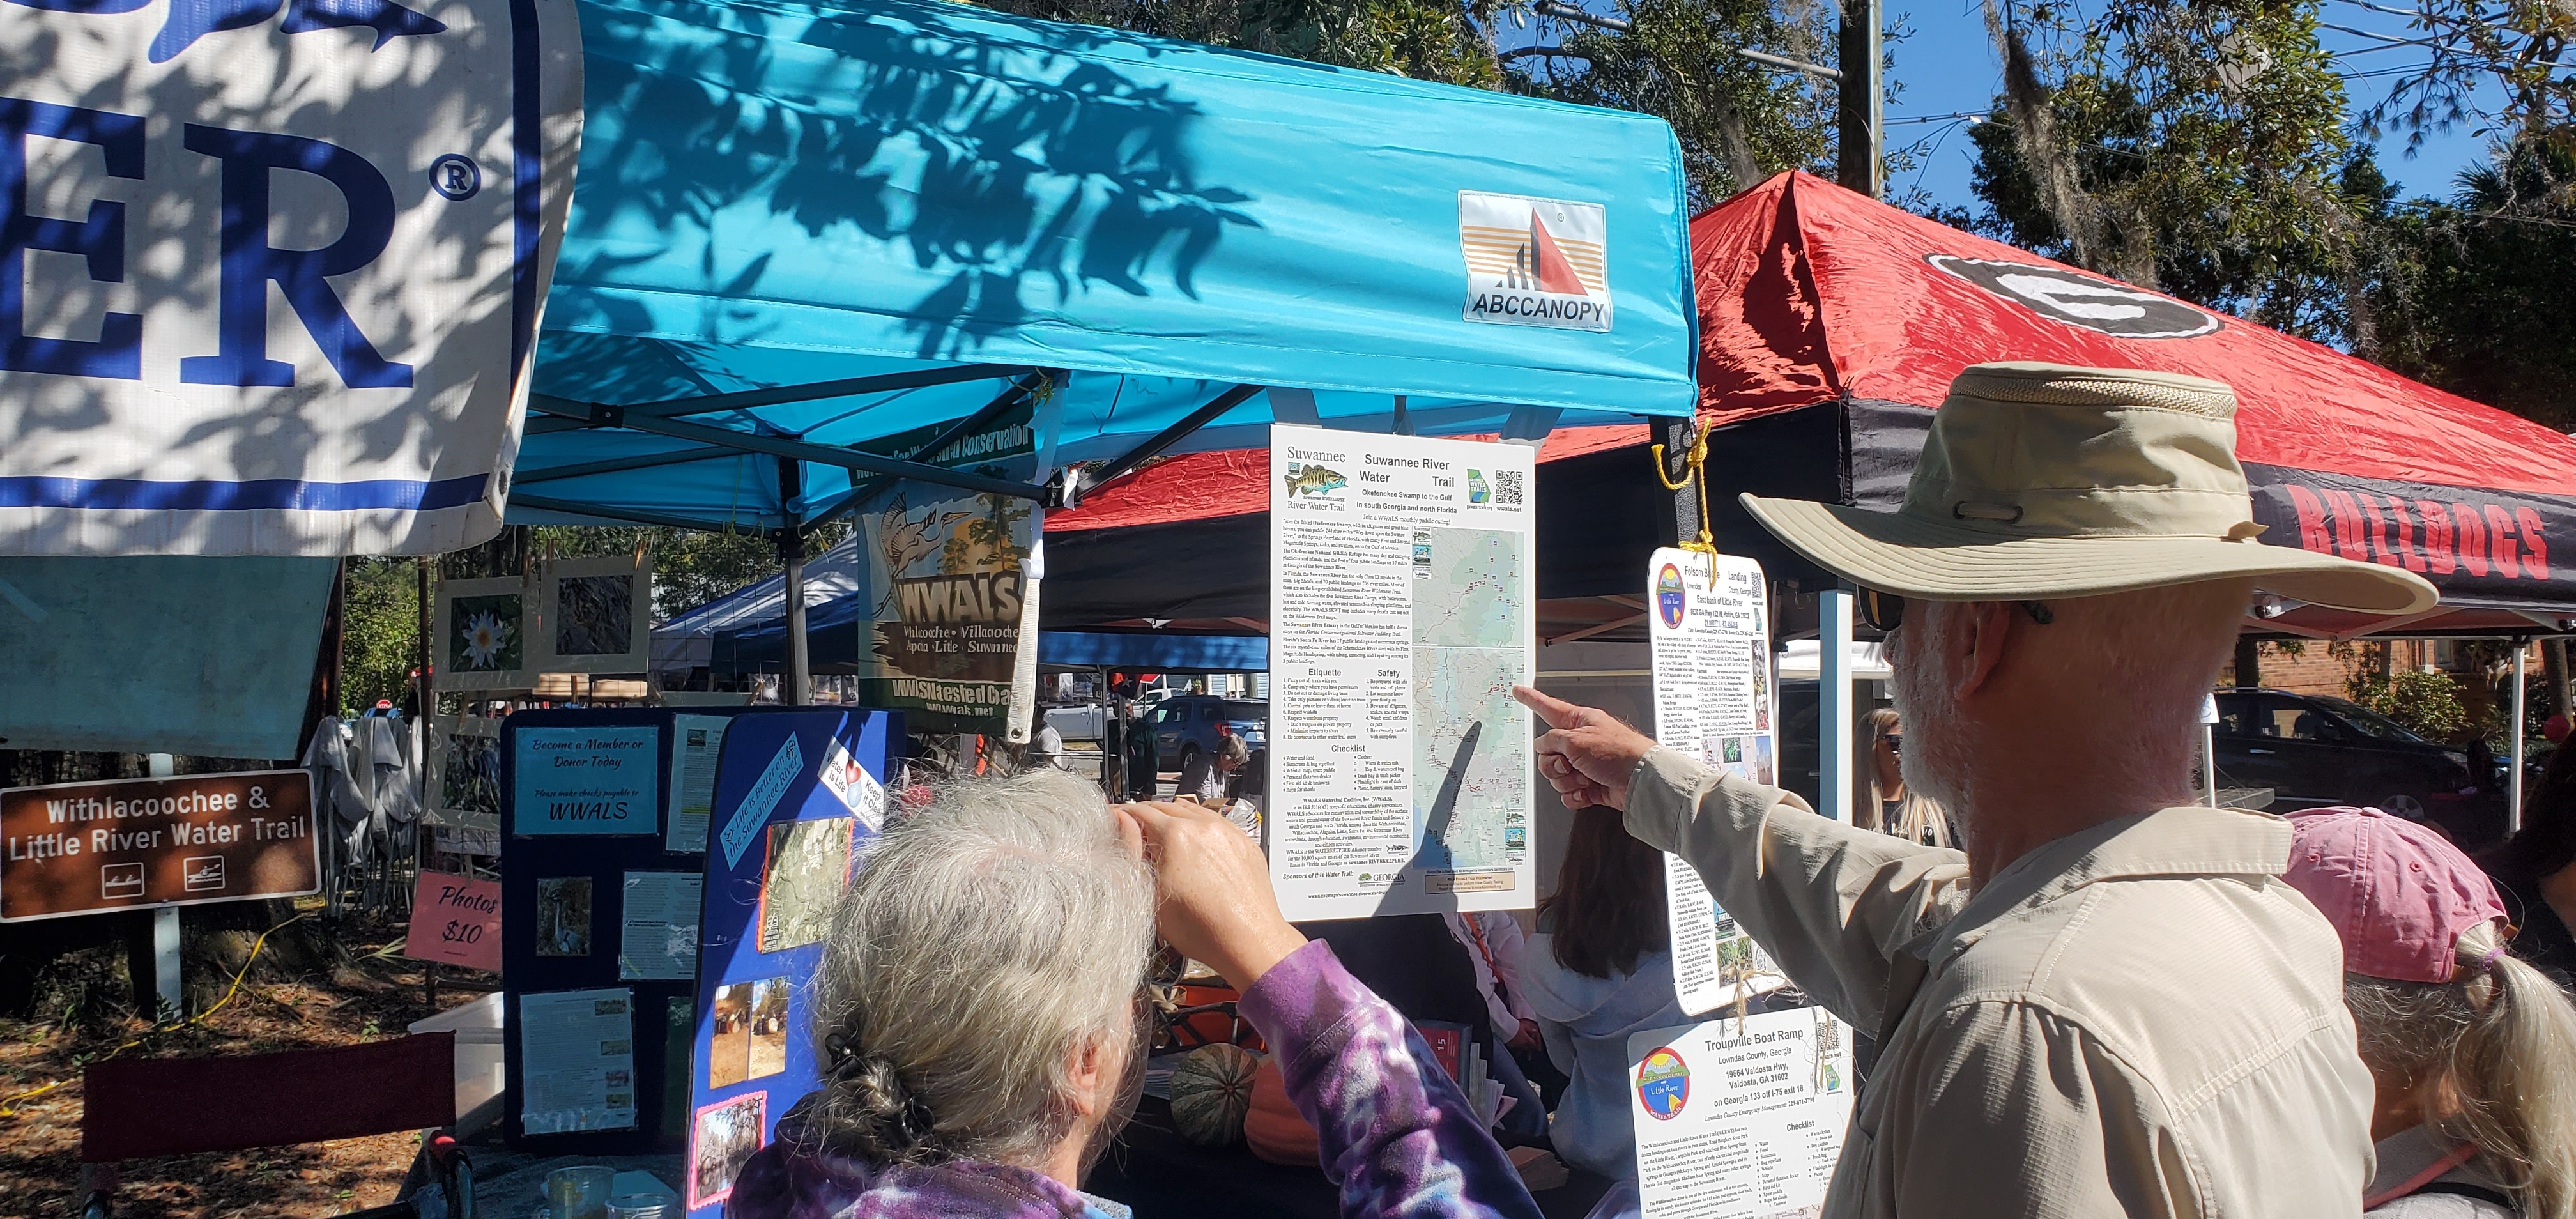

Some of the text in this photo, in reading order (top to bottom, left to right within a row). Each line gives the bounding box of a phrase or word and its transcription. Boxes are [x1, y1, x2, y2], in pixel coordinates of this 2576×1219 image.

[1472, 293, 1605, 322] ABCCANOPY
[962, 422, 1029, 457] Conservation
[1287, 446, 1346, 463] Suwannee
[1365, 454, 1449, 470] Suwannee River
[1360, 470, 1454, 487] Water Trail
[1361, 489, 1397, 497] Okefenokee
[1399, 491, 1420, 500] Swamp
[1287, 500, 1344, 511] River Water Trail
[1383, 503, 1406, 511] Georgia
[2285, 484, 2549, 580] BULLDOGS
[1684, 565, 1703, 576] Folsom
[1728, 571, 1747, 584] Landing
[898, 576, 1020, 623] WWALS
[1740, 587, 1751, 596] Georgia
[1696, 595, 1706, 603] East
[1706, 595, 1717, 604] bank
[1722, 597, 1732, 606] Little
[1732, 598, 1743, 606] River
[1308, 668, 1342, 677] Etiquette
[1377, 669, 1400, 678] Safety
[532, 739, 572, 751] Become
[583, 737, 629, 751] Member
[1331, 744, 1366, 753] Checklist
[553, 755, 622, 769] Donor Today
[827, 751, 843, 776] Water
[829, 770, 846, 793] is Life
[534, 788, 556, 797] Please
[557, 788, 578, 797] make
[578, 788, 602, 797] checks
[602, 788, 630, 799] payable
[735, 756, 785, 829] Life is Better on
[865, 779, 880, 802] Keep
[46, 786, 271, 824] Withlacoochee &
[549, 802, 629, 820] WWALS
[730, 838, 742, 859] the
[742, 785, 779, 838] Suwannee
[778, 755, 798, 786] River
[862, 794, 884, 819] it Clean
[10, 815, 305, 861] Little River Water Trail
[1373, 873, 1406, 882] GEORGIA
[438, 886, 498, 914] Photos
[442, 919, 483, 944] $10
[1438, 1038, 1446, 1050] 15
[1705, 1029, 1803, 1051] Troupville Boat Ramp
[1718, 1046, 1791, 1064] Lowndes County, Georgia
[1726, 1062, 1788, 1080] 19664 Valdosta Hwy,
[1728, 1073, 1788, 1089] Valdosta, GA 31602
[1650, 1084, 1678, 1095] Little River
[1723, 1094, 1748, 1105] Georgia
[1749, 1091, 1761, 1100] 133
[1761, 1089, 1770, 1098] off
[1771, 1087, 1782, 1096] I-75
[1784, 1086, 1795, 1094] exit
[1650, 1107, 1682, 1120] WATER TRAIL
[1705, 1113, 1722, 1121] Lowndes
[1786, 1119, 1814, 1131] Checklist
